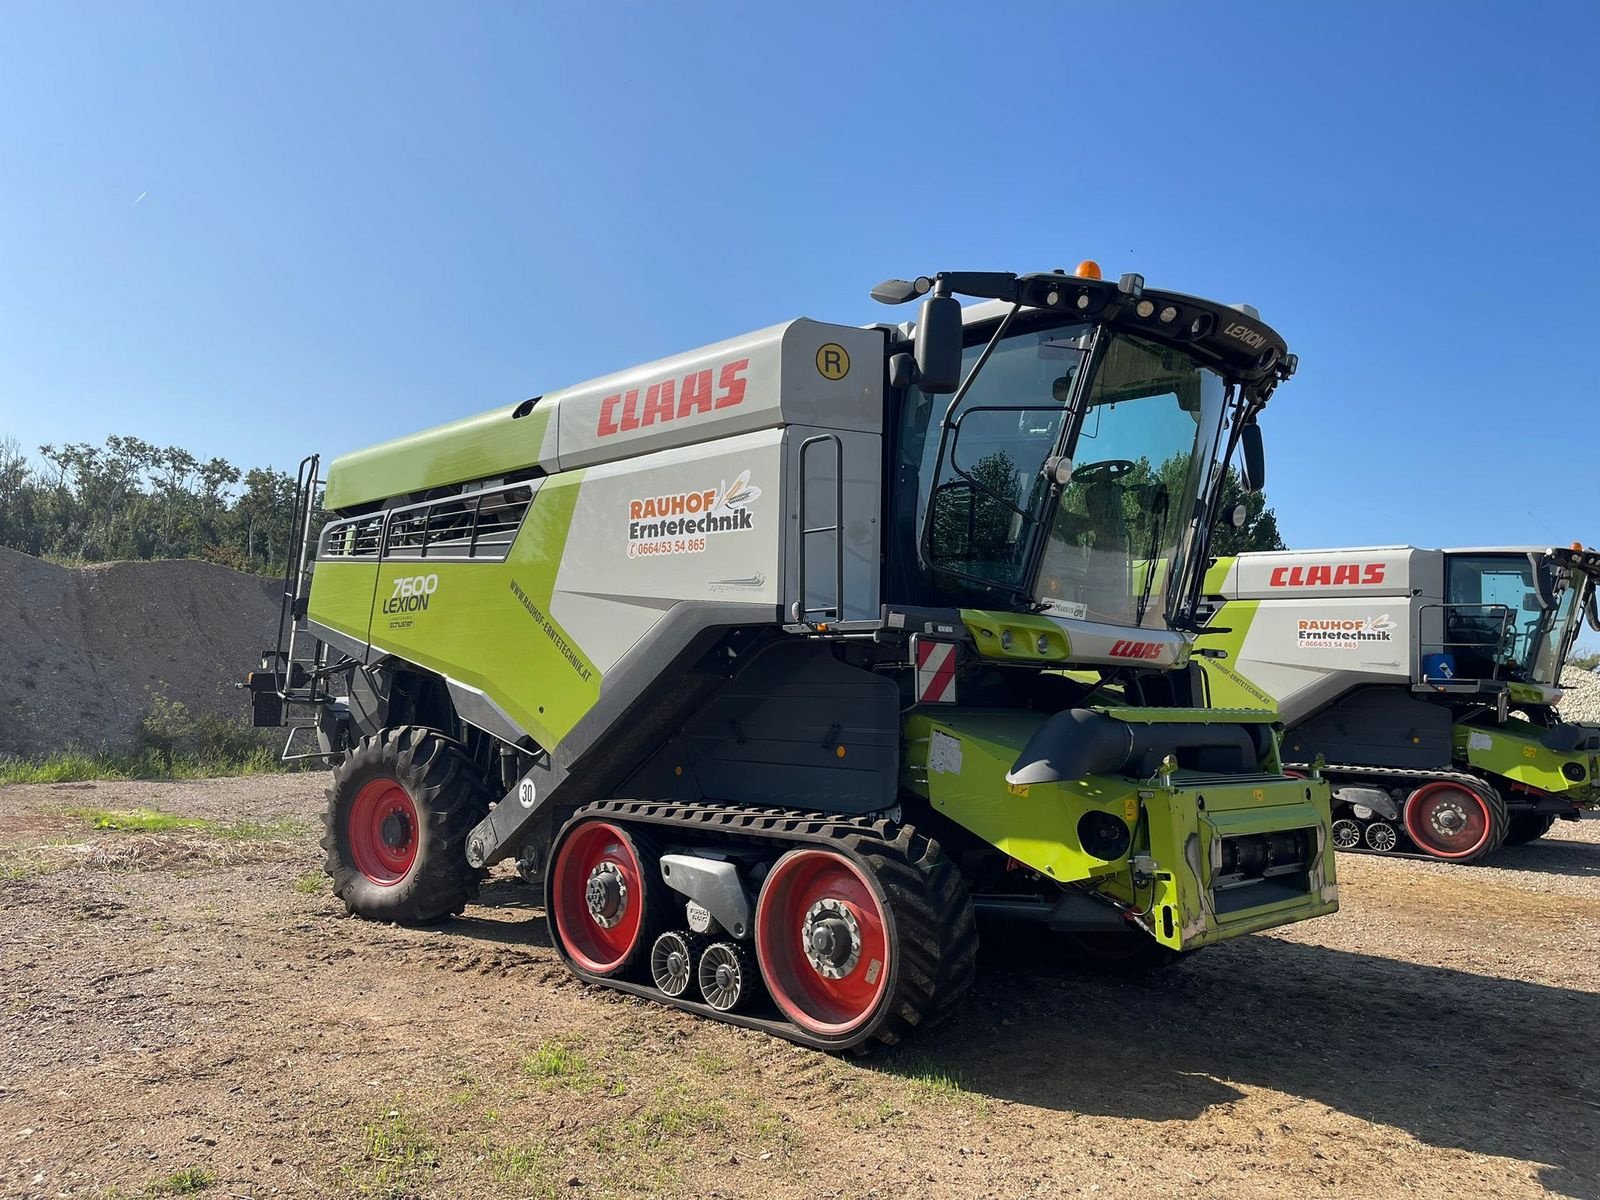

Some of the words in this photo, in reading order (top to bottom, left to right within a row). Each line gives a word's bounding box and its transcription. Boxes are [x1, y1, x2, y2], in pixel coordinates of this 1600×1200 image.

[1224, 322, 1265, 349] LEXION
[824, 350, 842, 373] R
[597, 358, 749, 437] CLAAS
[630, 491, 716, 520] RAUHOF
[629, 508, 753, 540] Erntetechnik
[638, 541, 672, 555] 0664/53
[674, 541, 686, 552] 54
[688, 538, 705, 551] 865
[1270, 563, 1386, 586] CLAAS
[391, 574, 438, 599] 7600
[383, 594, 430, 615] LEXION
[509, 578, 592, 682] WWW.RAUHOF-ERNTETECHNIK.AT
[1298, 620, 1363, 631] RAUHOF
[1298, 630, 1391, 641] Erntetechnik
[1109, 640, 1164, 659] CLAAS
[1334, 640, 1342, 648] 54
[522, 784, 533, 802] 30
